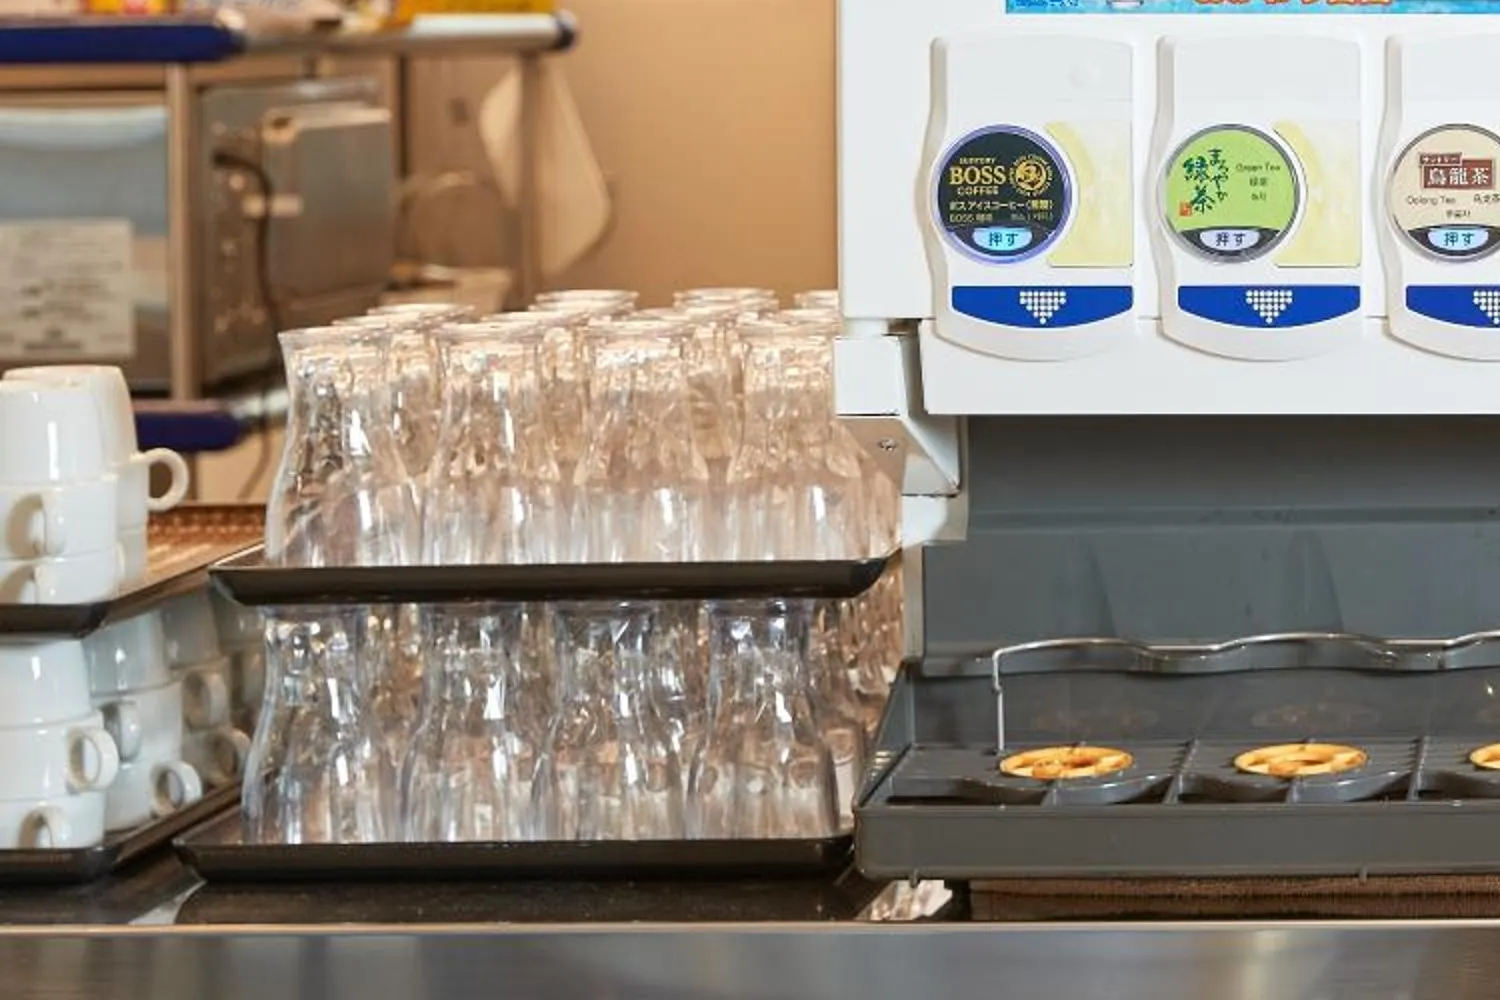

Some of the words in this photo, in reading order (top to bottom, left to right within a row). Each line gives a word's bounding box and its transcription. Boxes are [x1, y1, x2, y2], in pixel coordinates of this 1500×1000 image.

[949, 165, 1007, 185] BOSS
[957, 186, 999, 196] COFFEE
[989, 232, 1018, 246] 押す
[1216, 232, 1246, 246] 押す
[1444, 232, 1474, 247] 押す
